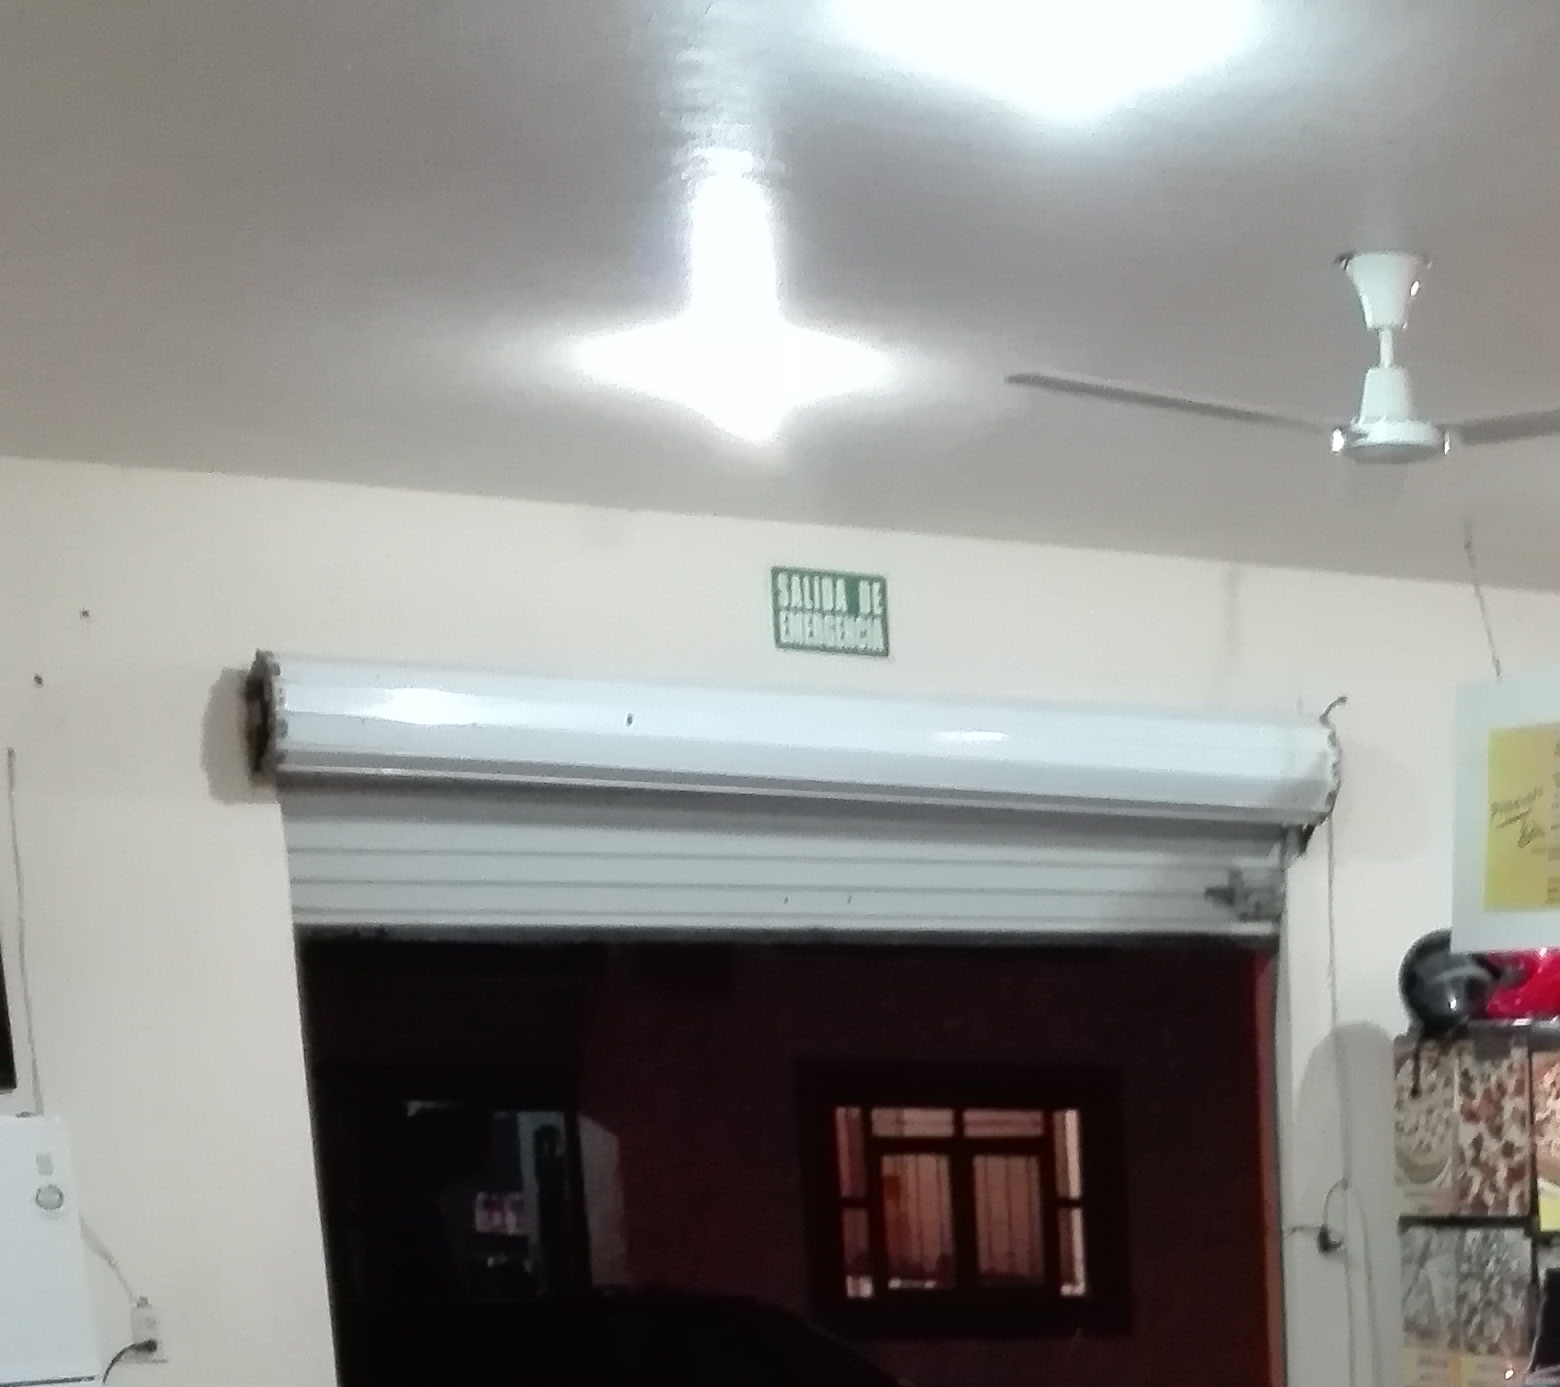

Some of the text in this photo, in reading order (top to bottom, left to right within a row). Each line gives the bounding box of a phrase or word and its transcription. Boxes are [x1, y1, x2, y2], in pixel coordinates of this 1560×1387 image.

[777, 572, 884, 616] SALIDA DE
[779, 609, 885, 652] EMERGENCIA
